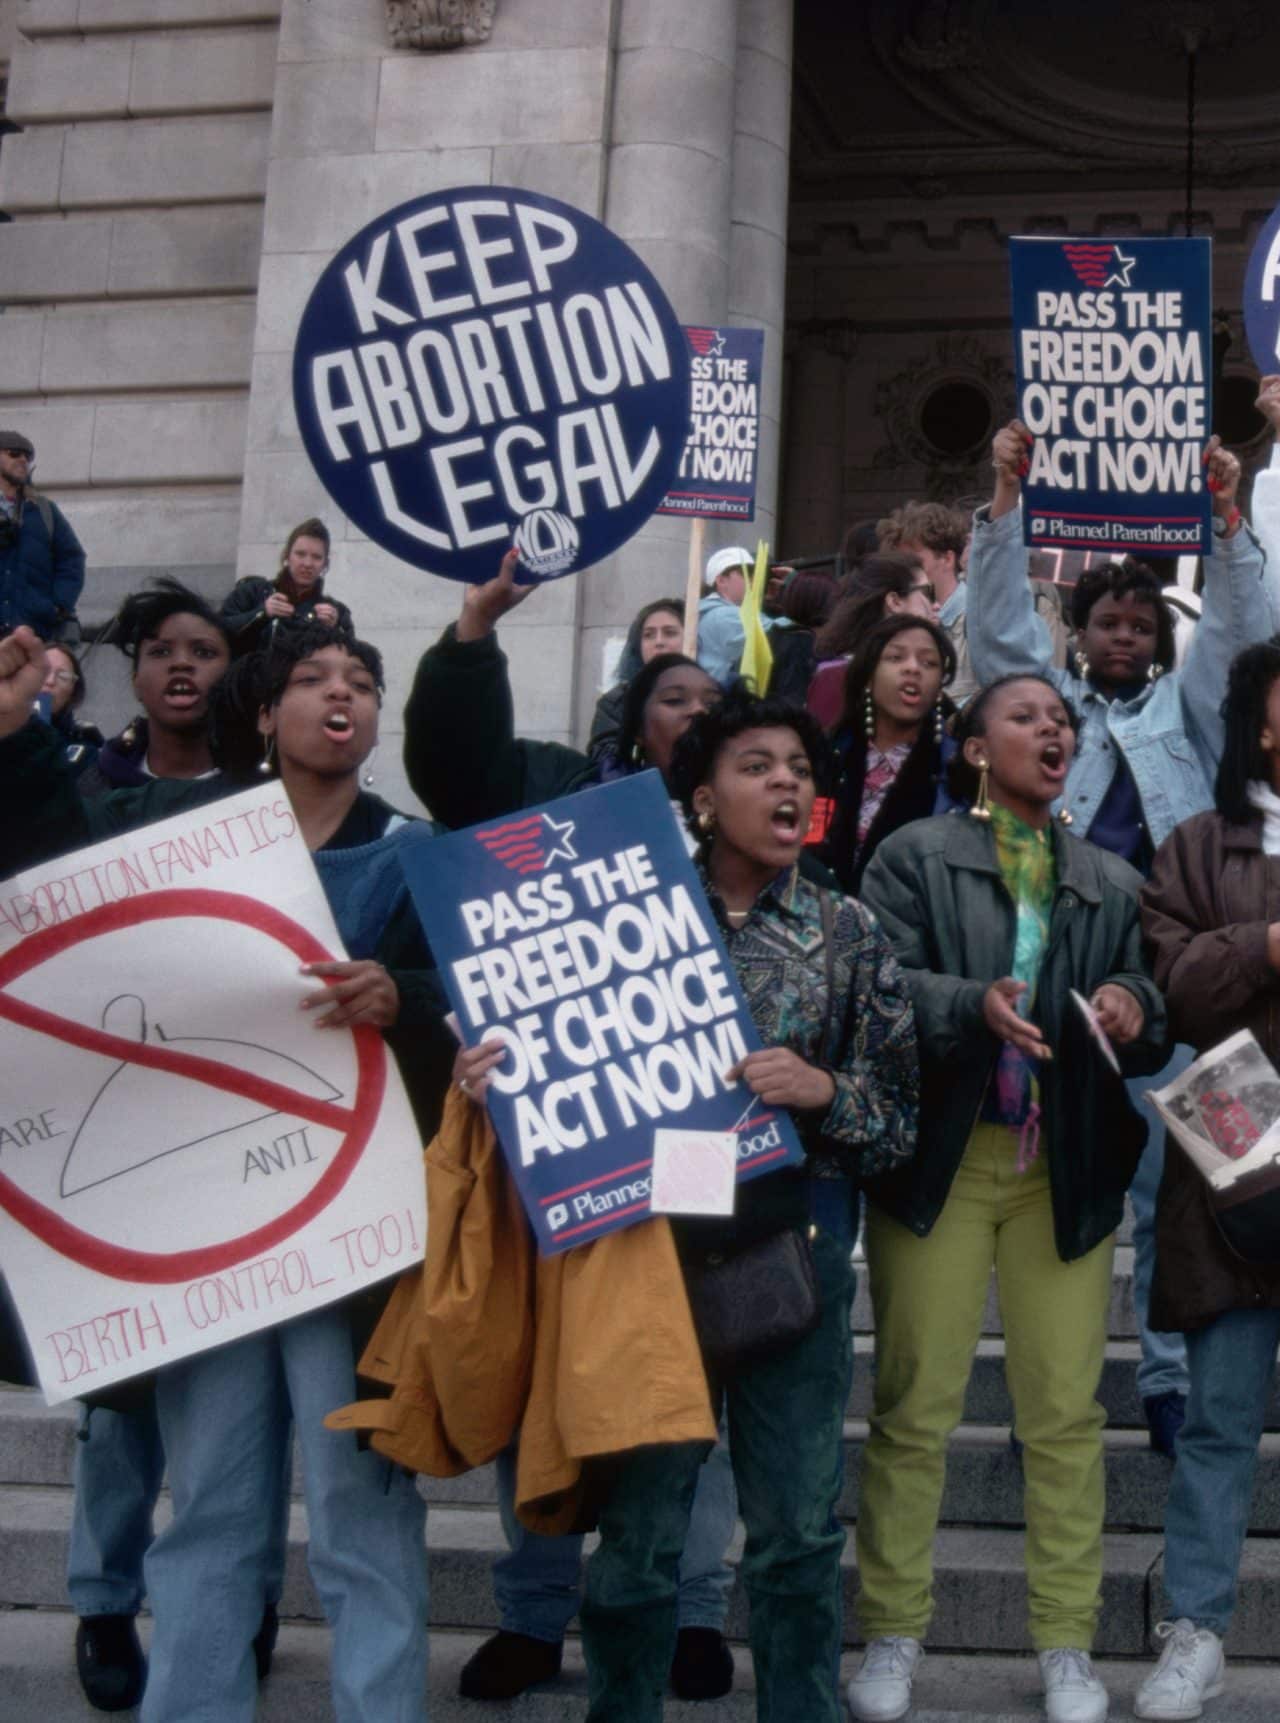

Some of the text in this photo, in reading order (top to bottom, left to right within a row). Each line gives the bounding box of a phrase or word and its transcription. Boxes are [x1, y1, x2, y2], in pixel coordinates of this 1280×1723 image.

[344, 200, 578, 333] KEEP
[1037, 291, 1182, 328] PASS THE
[312, 281, 671, 462] ABORTION
[715, 358, 748, 381] THE
[1020, 329, 1204, 383] FREEDOM
[1022, 382, 1206, 440] OF CHOICE
[369, 402, 661, 551] LEGAL
[692, 448, 753, 484] NOW!
[1027, 439, 1202, 494] ACT NOW!
[1050, 520, 1202, 542] Planned Parenthood
[150, 800, 296, 892] FANATICS
[460, 843, 659, 947] PASS THE
[452, 883, 711, 1028] FREEDOM
[479, 949, 739, 1095] OF CHOICE
[242, 1127, 318, 1184] ANTI
[514, 1070, 608, 1168] ACT
[47, 1208, 420, 1384] BIRTH CONTROL TOO!
